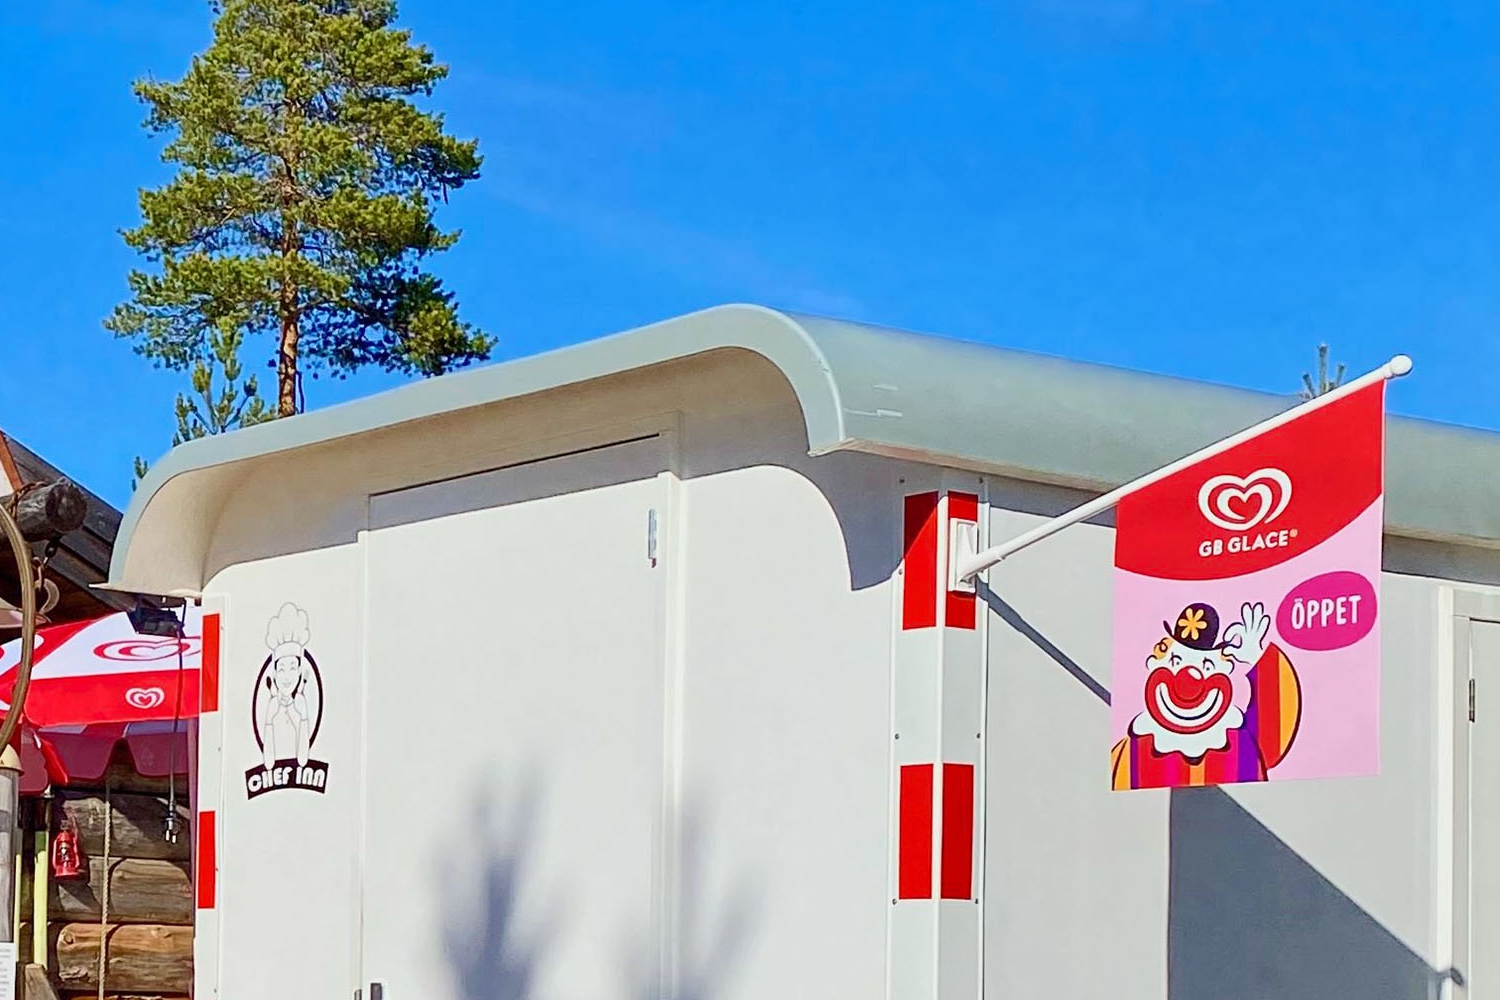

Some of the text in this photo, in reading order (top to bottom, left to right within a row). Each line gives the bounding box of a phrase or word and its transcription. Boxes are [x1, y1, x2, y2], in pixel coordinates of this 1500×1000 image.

[1199, 539, 1223, 557] GB
[1291, 595, 1362, 630] ÖPPET
[247, 766, 294, 793] CHEF
